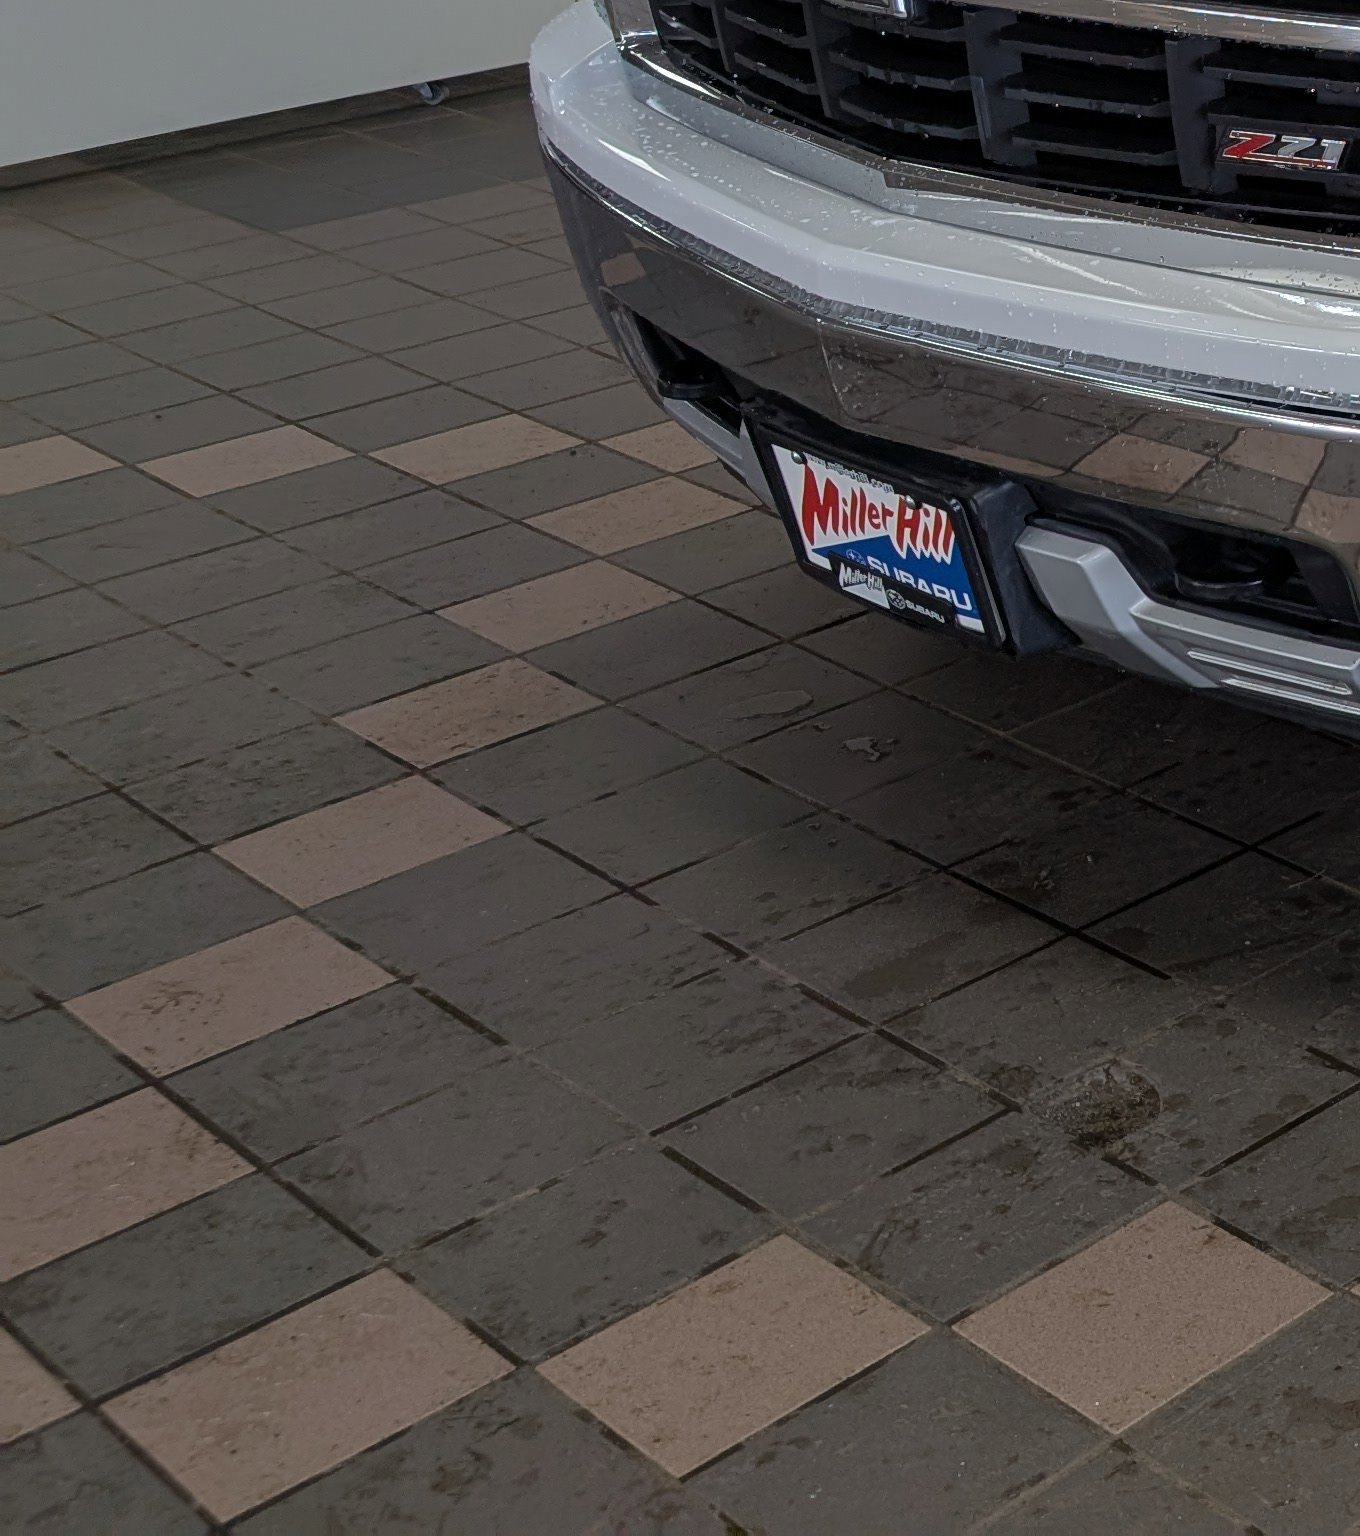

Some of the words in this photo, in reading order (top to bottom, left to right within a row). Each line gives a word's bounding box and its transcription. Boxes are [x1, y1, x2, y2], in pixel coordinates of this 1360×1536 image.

[1222, 129, 1347, 170] Z71
[802, 464, 894, 547] Miller
[896, 495, 955, 558] Hill
[905, 599, 946, 624] SUBARU
